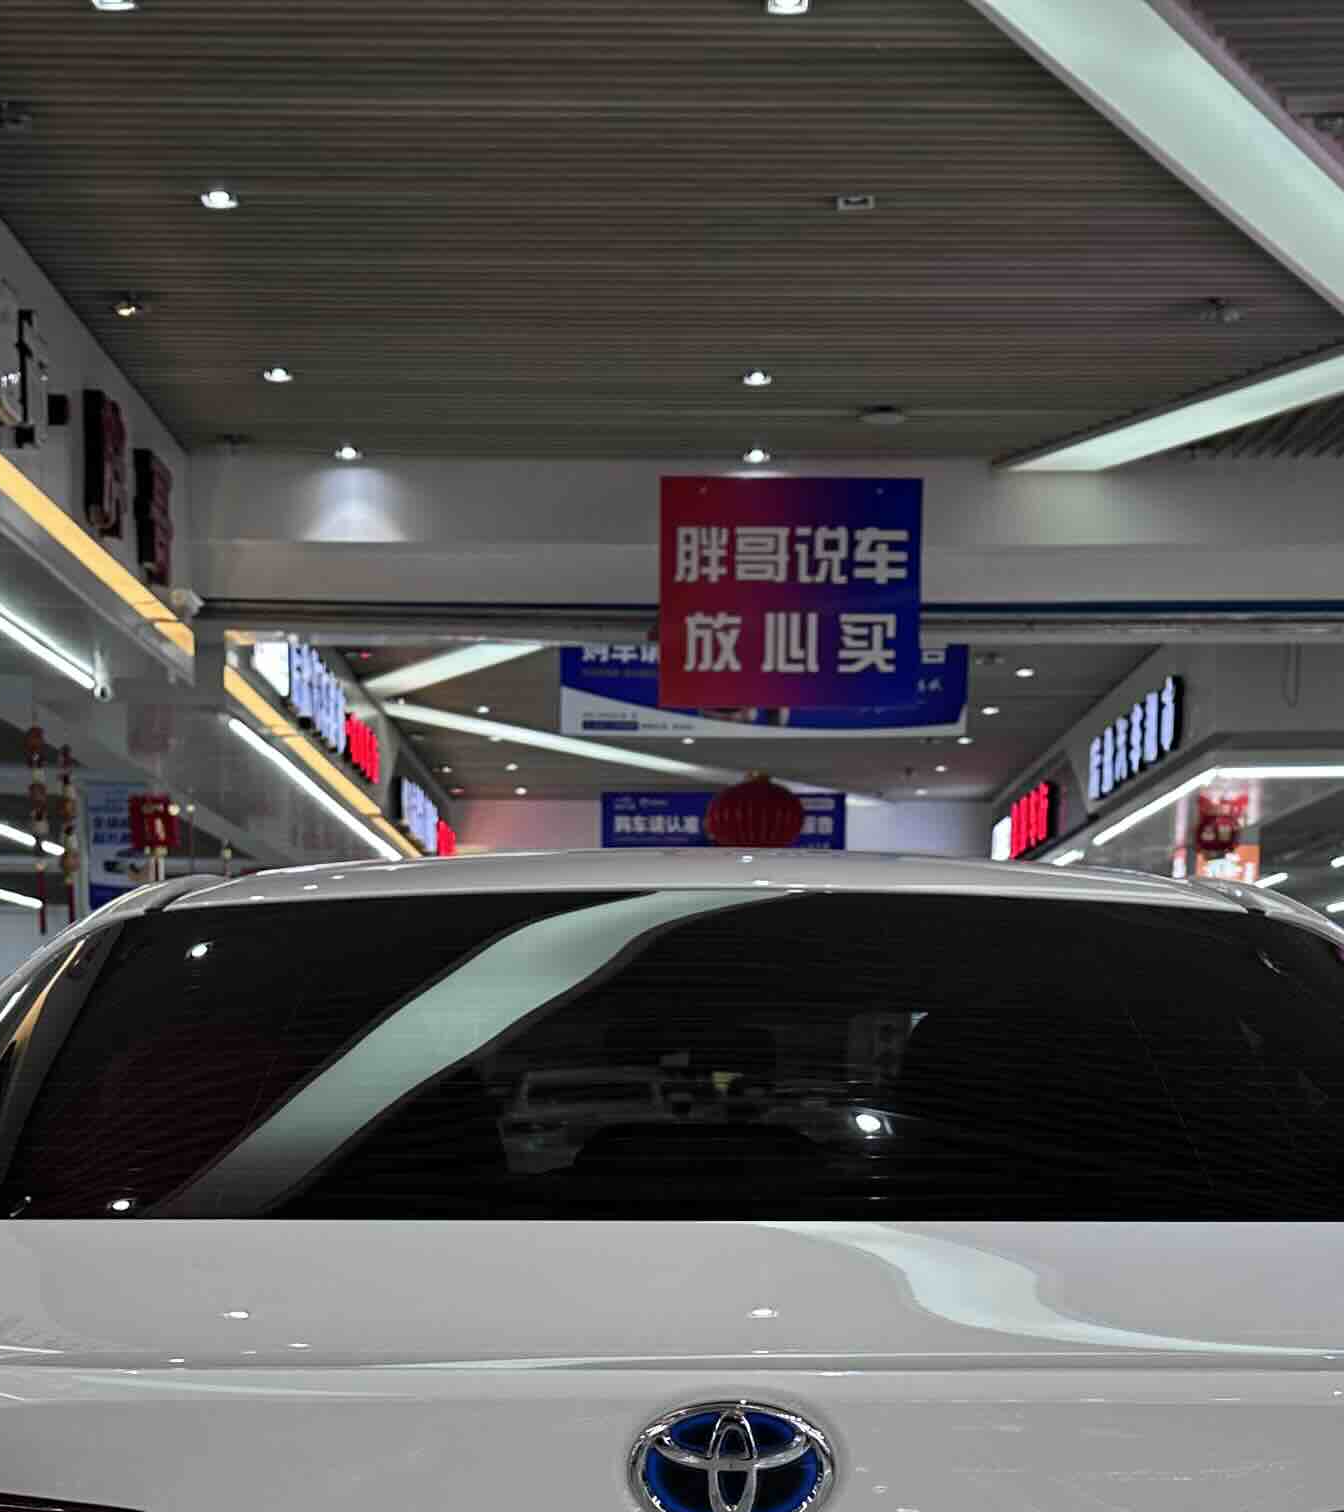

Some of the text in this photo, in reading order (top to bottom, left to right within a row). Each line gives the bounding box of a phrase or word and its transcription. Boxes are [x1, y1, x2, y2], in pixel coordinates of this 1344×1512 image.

[674, 525, 910, 585] 胖哥说车
[683, 612, 898, 674] 放心买
